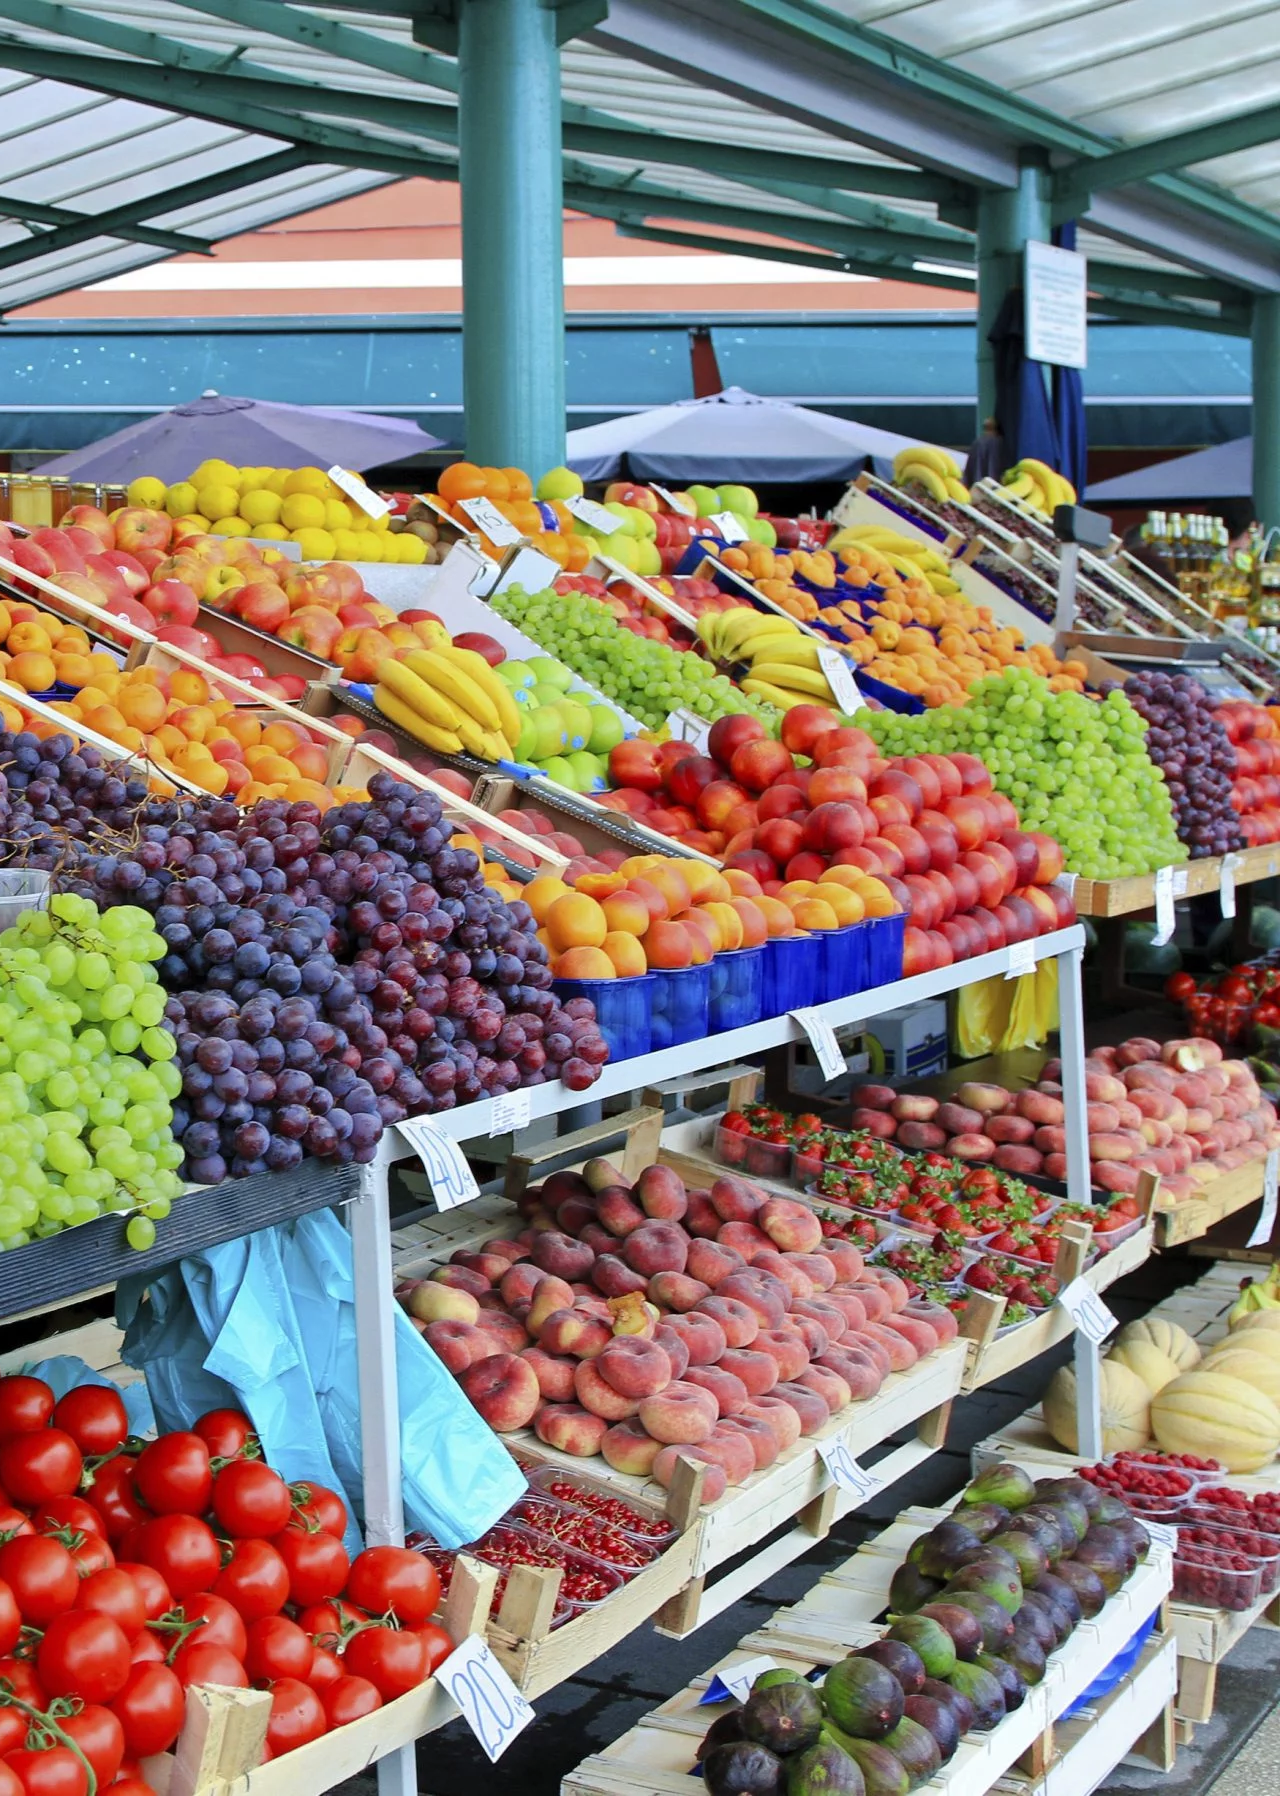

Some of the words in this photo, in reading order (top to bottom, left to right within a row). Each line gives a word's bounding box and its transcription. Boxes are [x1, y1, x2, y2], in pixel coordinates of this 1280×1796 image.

[631, 834, 680, 857] INTEGRAT
[406, 1126, 465, 1205] 40
[1072, 1299, 1107, 1340] 20
[826, 1445, 872, 1497] 50
[451, 1659, 514, 1758] 20
